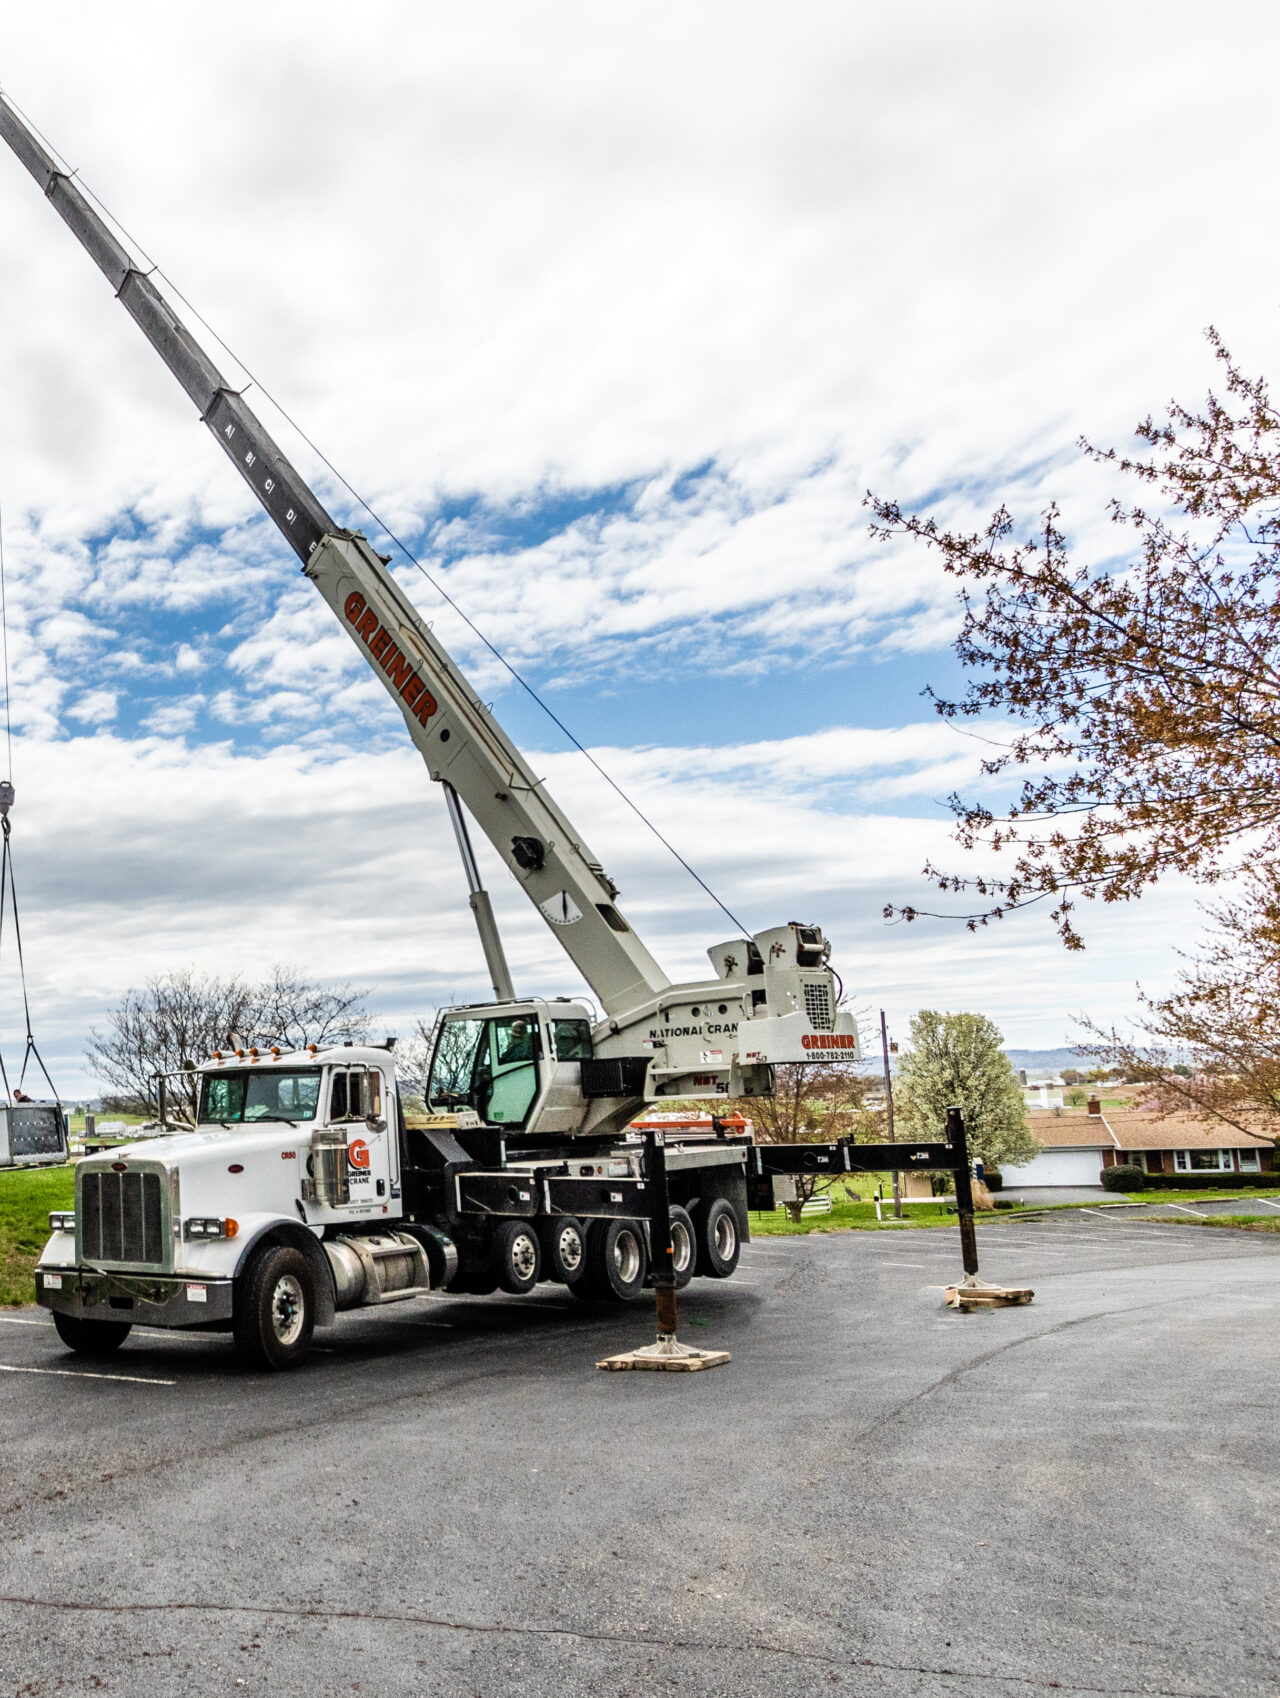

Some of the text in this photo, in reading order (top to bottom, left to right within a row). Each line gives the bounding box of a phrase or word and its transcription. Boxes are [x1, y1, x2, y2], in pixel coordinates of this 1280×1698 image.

[344, 591, 438, 729] GREINER
[649, 1023, 738, 1038] NATIONAL CRAN
[801, 1034, 855, 1049] GREINER
[806, 1051, 855, 1060] 1-800-782-2110
[693, 1076, 718, 1085] NBT
[348, 1138, 370, 1170] G
